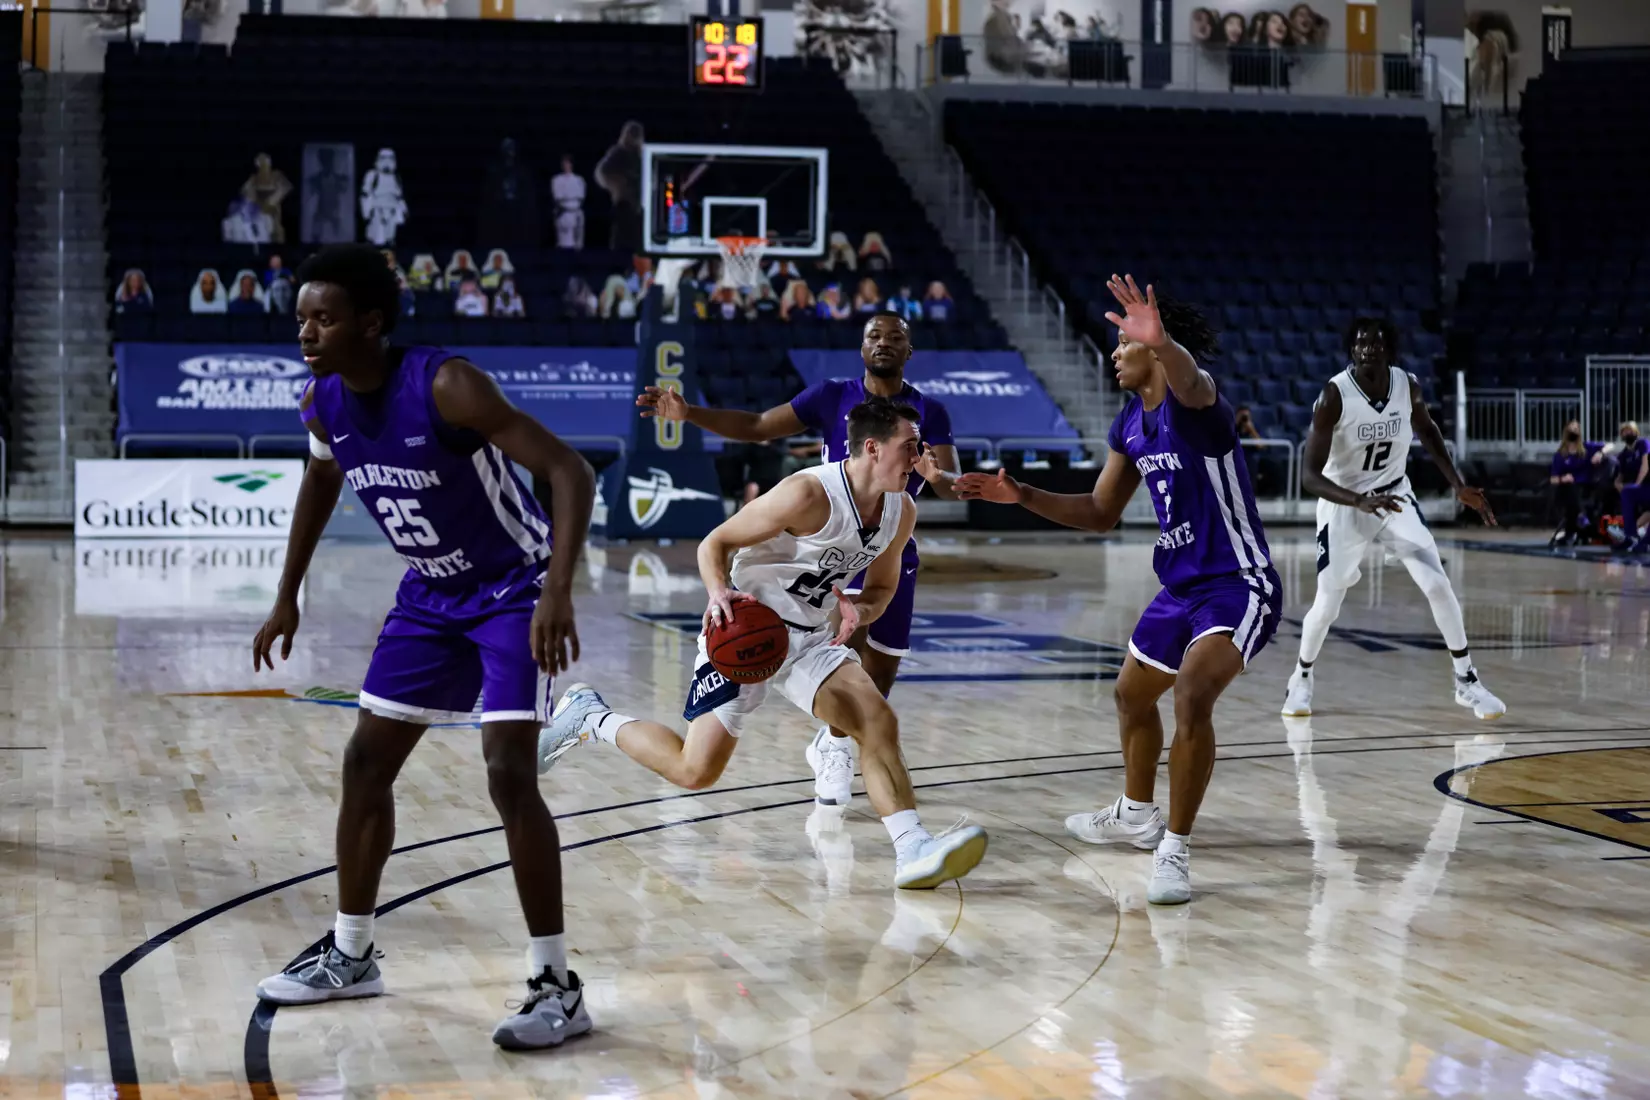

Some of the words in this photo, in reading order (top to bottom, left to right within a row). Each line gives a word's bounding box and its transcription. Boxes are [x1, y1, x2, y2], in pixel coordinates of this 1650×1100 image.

[703, 44, 749, 84] 22
[1358, 418, 1402, 440] CBU
[1362, 441, 1393, 471] 12
[345, 463, 442, 491] TARLETON
[83, 498, 288, 528] GuideStone
[376, 496, 440, 546] 25
[818, 546, 876, 570] CU
[867, 544, 881, 552] WAC
